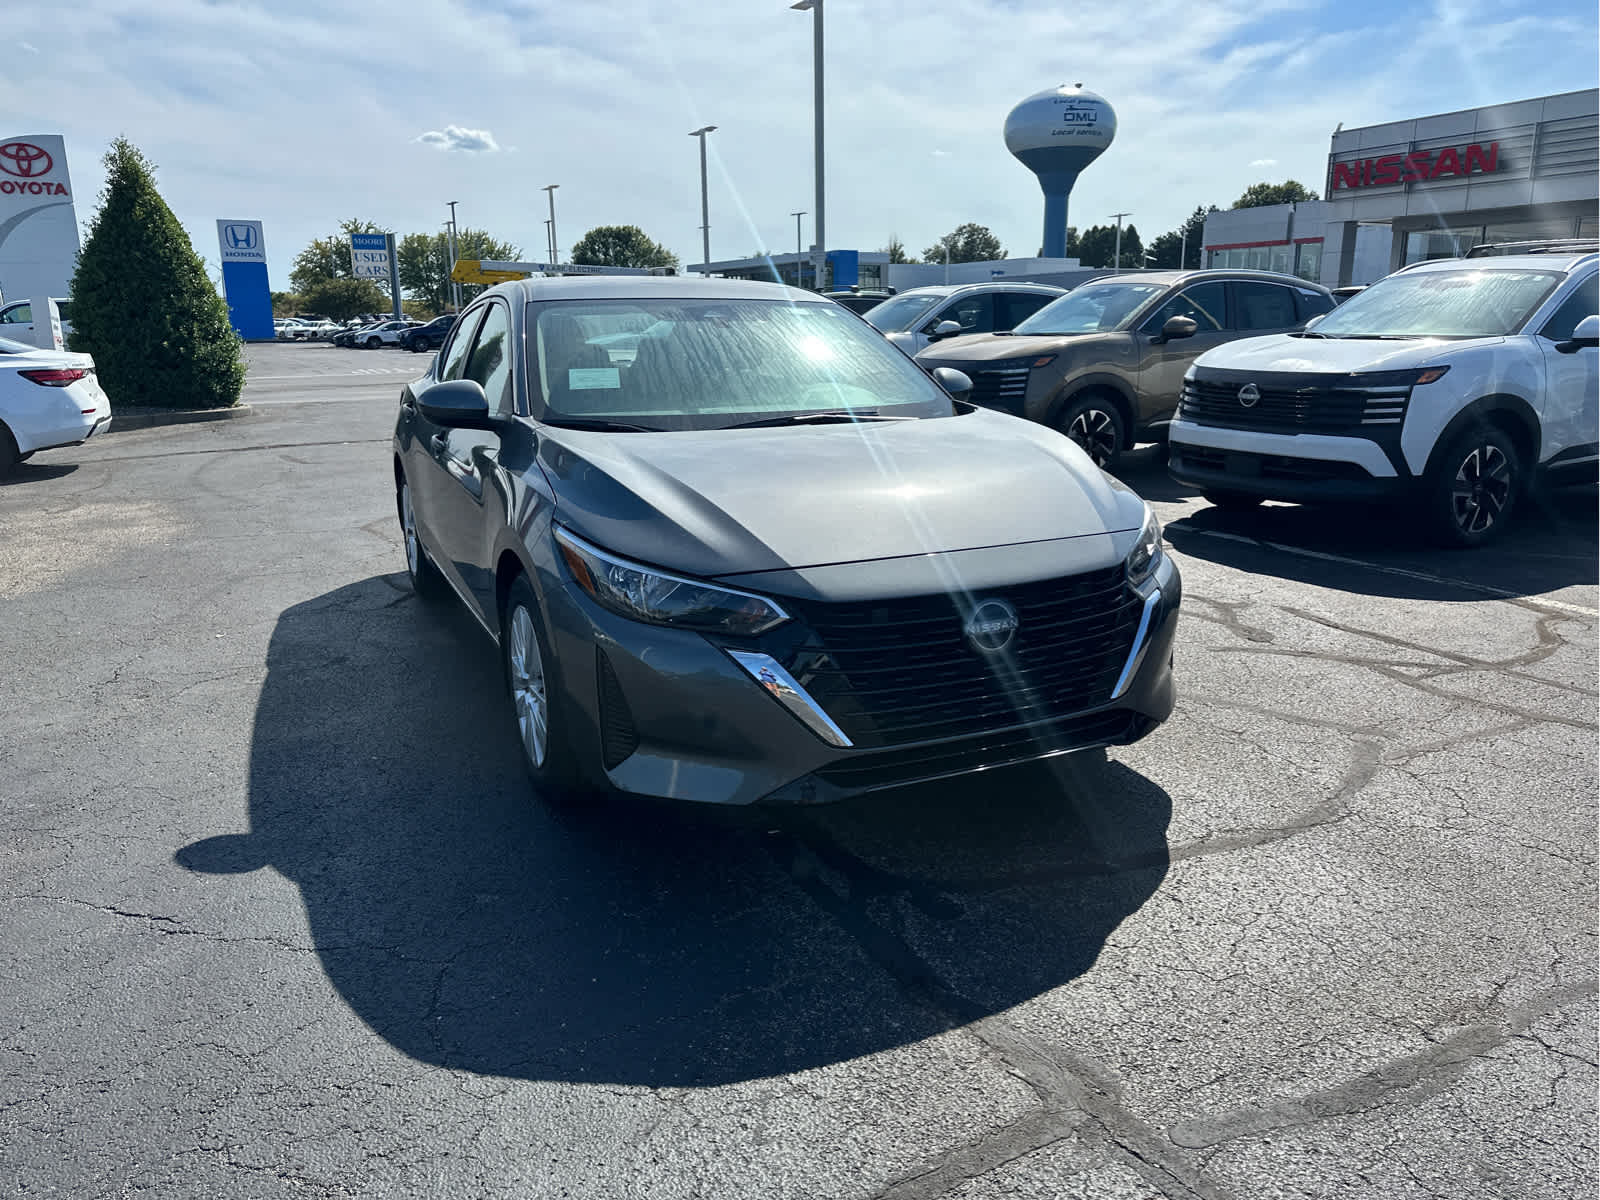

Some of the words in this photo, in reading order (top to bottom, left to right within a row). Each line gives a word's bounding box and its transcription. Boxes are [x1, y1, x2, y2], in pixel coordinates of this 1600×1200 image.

[1063, 112, 1097, 122] OMU
[1333, 142, 1499, 190] NISSAN
[0, 180, 69, 196] OYOTA
[353, 237, 385, 246] MOORE
[354, 252, 388, 262] USED
[355, 265, 389, 276] CARS
[965, 616, 1018, 635] NISSAN
